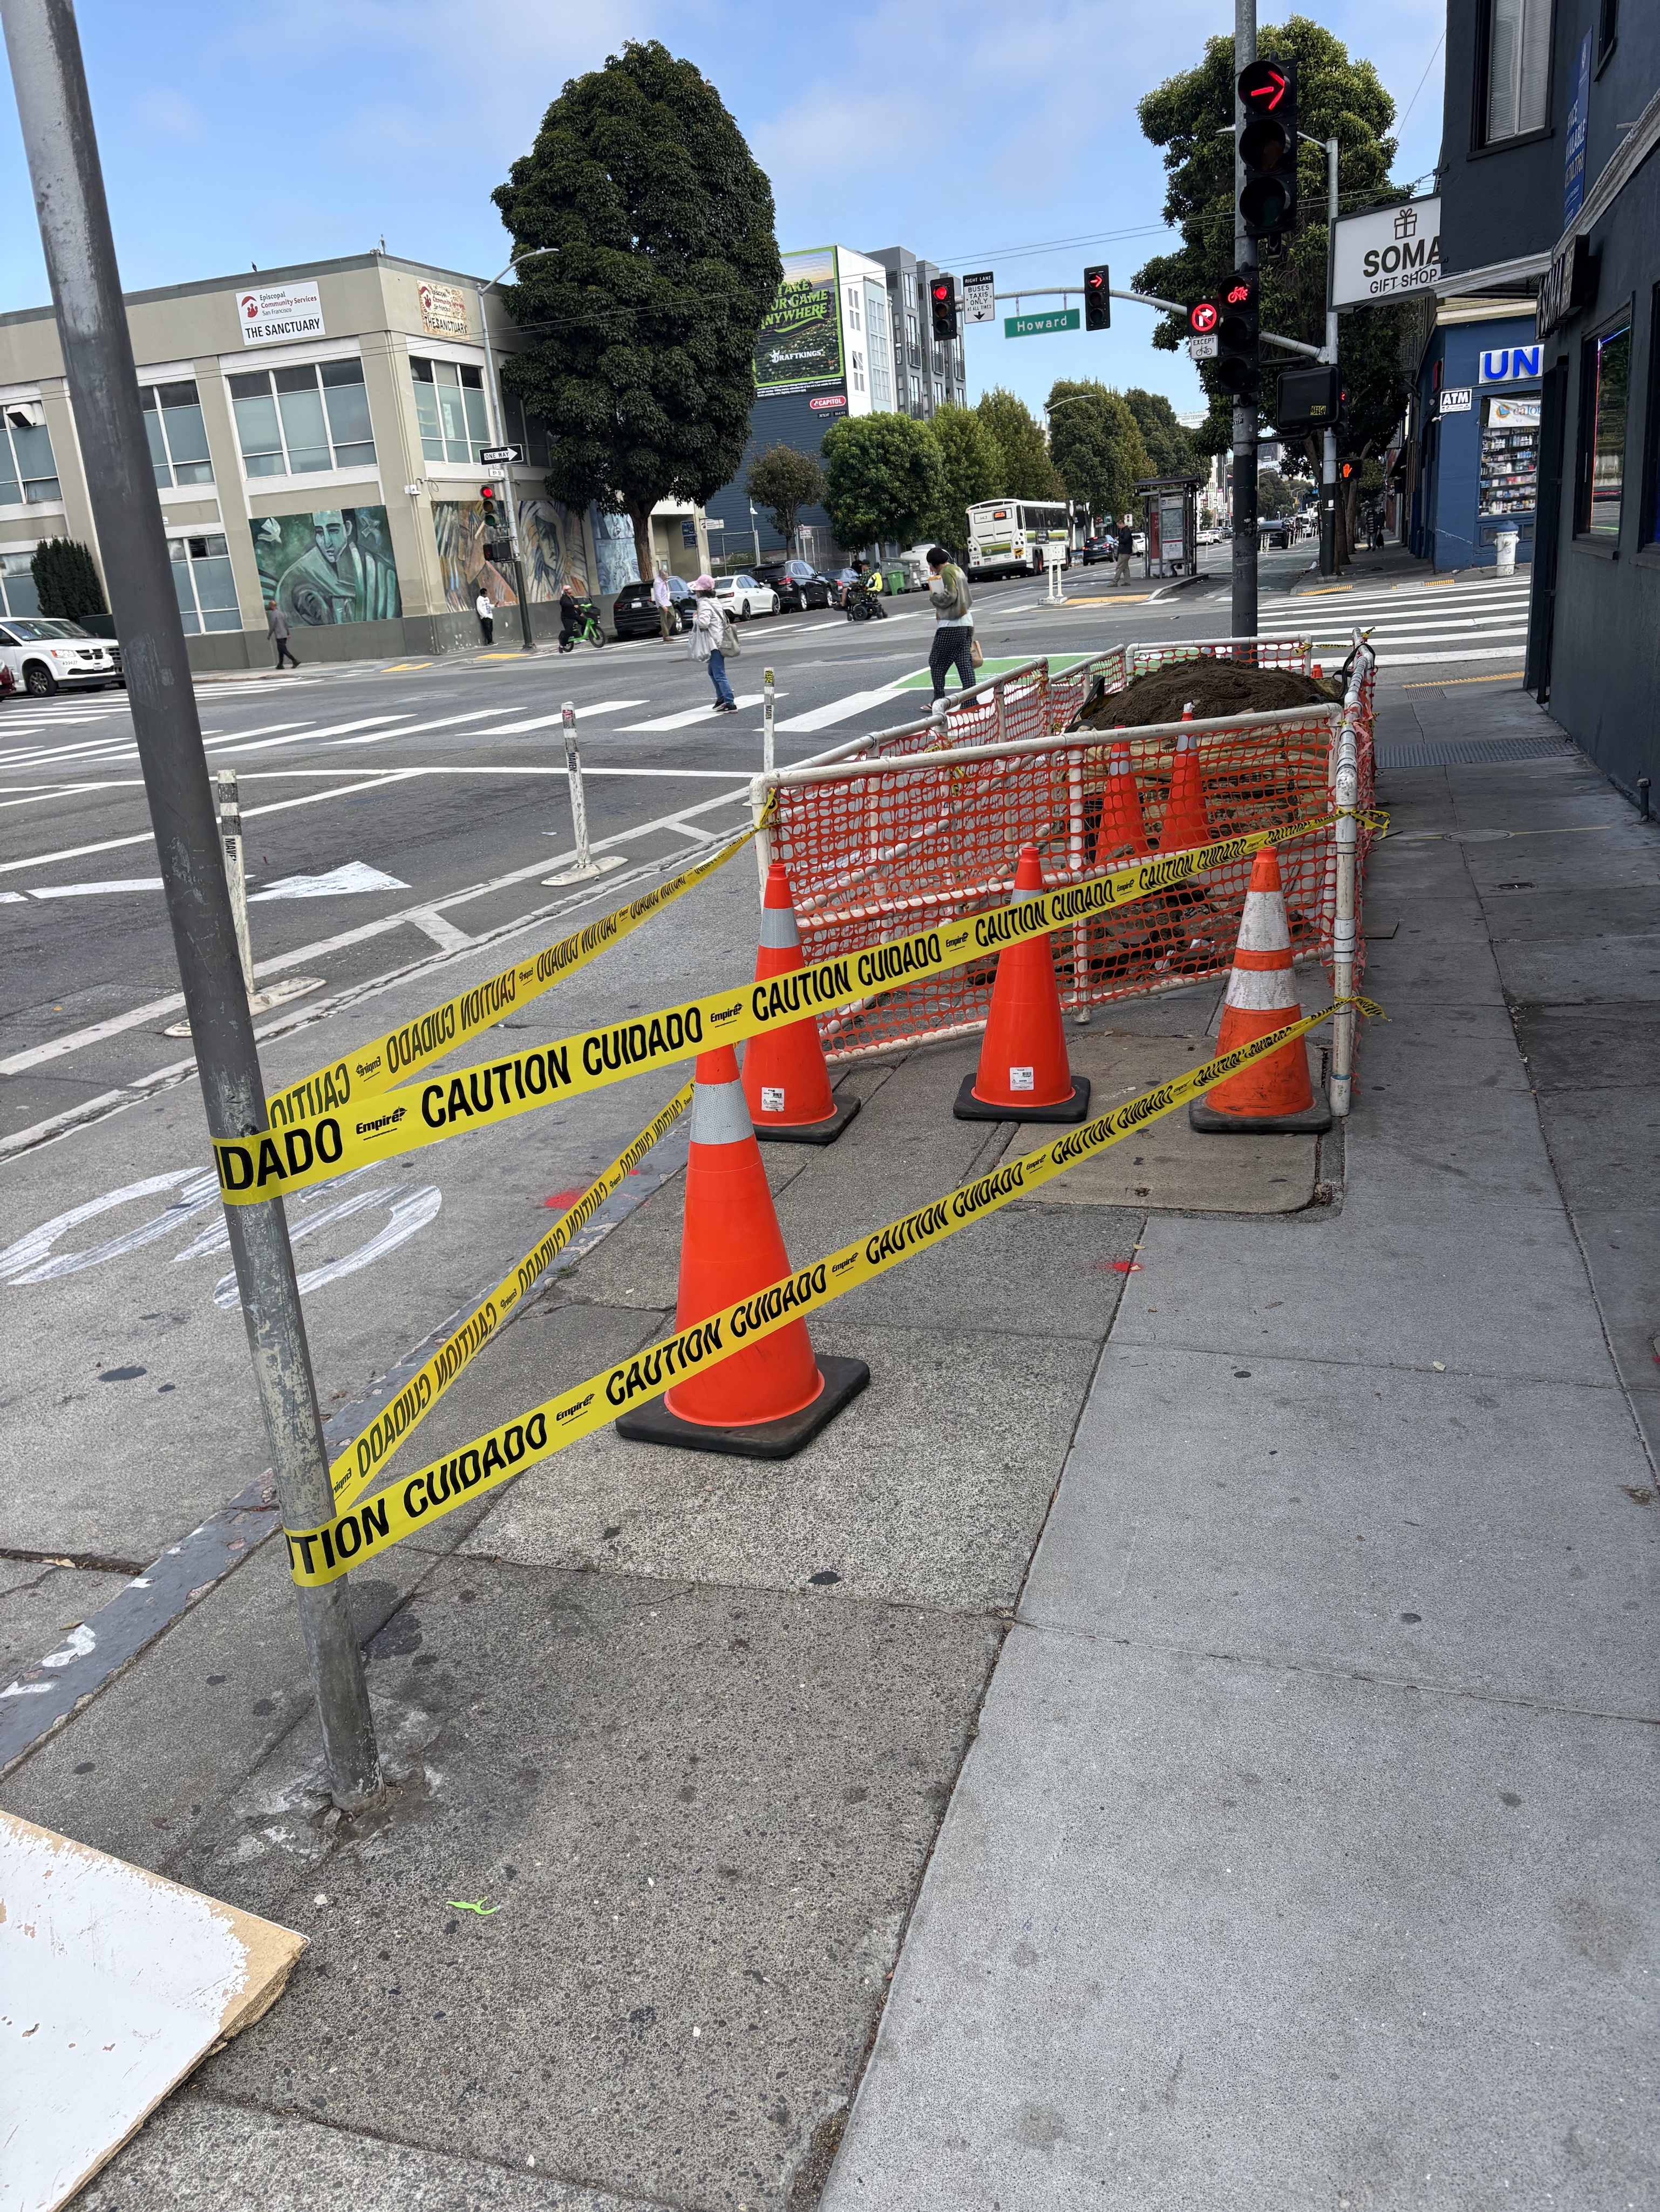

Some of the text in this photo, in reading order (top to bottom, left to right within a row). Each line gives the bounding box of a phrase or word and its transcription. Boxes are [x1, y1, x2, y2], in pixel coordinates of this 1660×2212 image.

[777, 278, 810, 297] TAKE
[968, 285, 989, 293] BUSES
[1370, 268, 1437, 294] GIFT SHOP
[259, 291, 286, 302] Episcopal
[261, 299, 293, 309] Community
[790, 289, 828, 308] GAME
[970, 298, 988, 306] ONLY
[245, 318, 320, 338] THE SANCTUARY
[435, 318, 467, 334] SANCTUARY
[1017, 316, 1067, 332] Howard
[1193, 337, 1215, 346] EXCEPT
[771, 350, 822, 363] DRAFTKINGS
[818, 398, 842, 407] CAPITOL
[1442, 392, 1468, 405] ATM
[567, 752, 577, 772] MAVEN
[356, 1109, 406, 1137] Empire
[421, 1046, 573, 1128] CAUTION
[583, 1007, 702, 1076] CUIDADO
[710, 1002, 743, 1023] Empire
[752, 966, 853, 1022] CAUTION
[858, 933, 942, 986] CUIDADO
[945, 932, 969, 948] Empire
[975, 898, 1050, 947] CAUTION
[1051, 879, 1114, 919] CUIDADO
[1117, 879, 1134, 892] Empire
[1139, 856, 1194, 890] CAUTION
[1198, 838, 1247, 870] CUIDADO
[403, 1412, 548, 1519] CUIDADO
[556, 1392, 596, 1423] Empire
[606, 1318, 720, 1406] CAUTION
[730, 1264, 827, 1338] CUIDADO
[831, 1252, 859, 1273] Empire
[866, 1200, 949, 1265] CAUTION
[952, 1161, 1024, 1218] CUIDADO
[1026, 1153, 1047, 1171] Empire
[1051, 1113, 1116, 1165] CAUTION
[1117, 1085, 1173, 1129] CUIDADO
[1193, 1047, 1246, 1087] CAUTION
